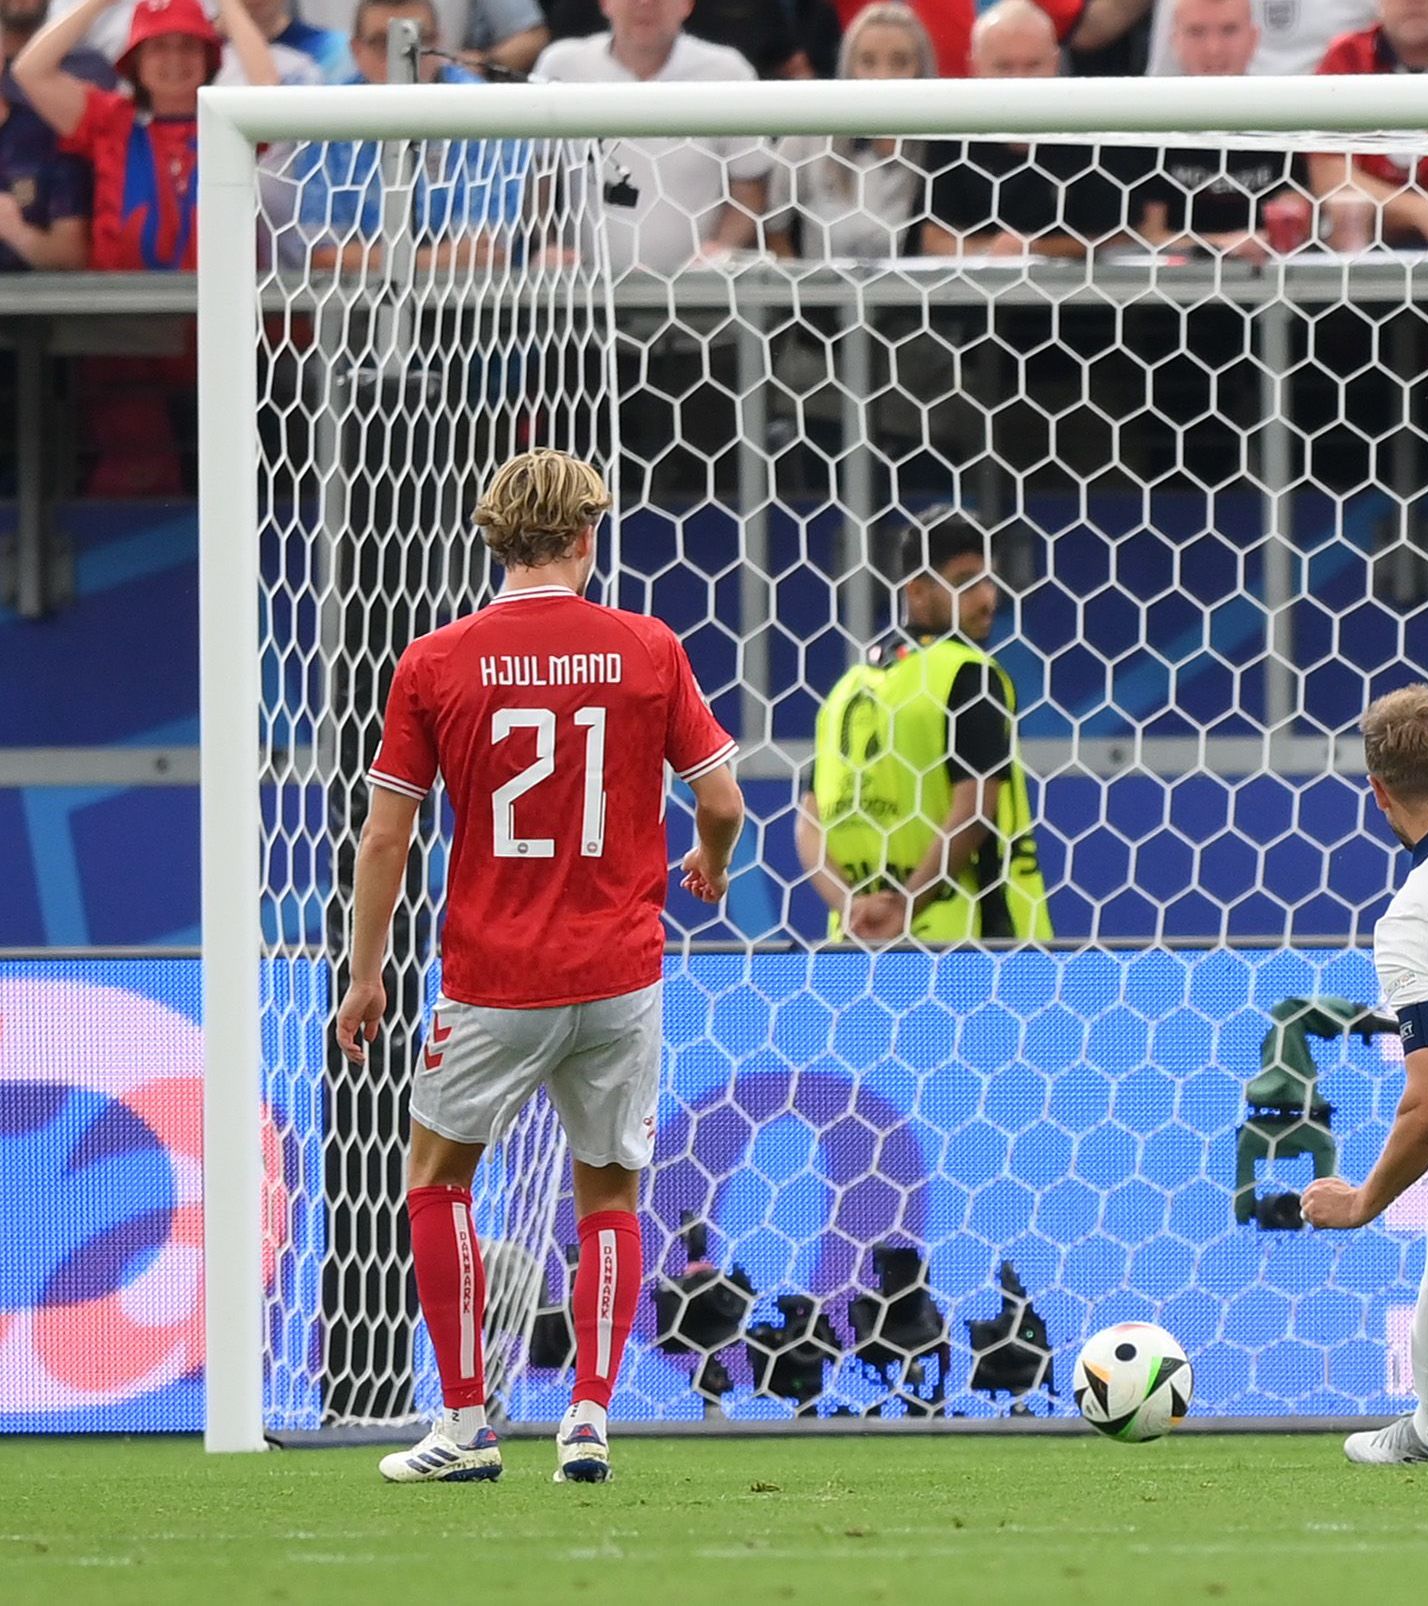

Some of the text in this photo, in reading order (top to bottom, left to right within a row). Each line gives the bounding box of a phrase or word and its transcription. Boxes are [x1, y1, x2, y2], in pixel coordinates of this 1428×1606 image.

[480, 653, 622, 686] HJULMAND
[491, 707, 607, 858] 21
[459, 1231, 471, 1314] DANMARK
[601, 1246, 613, 1319] DANMARK
